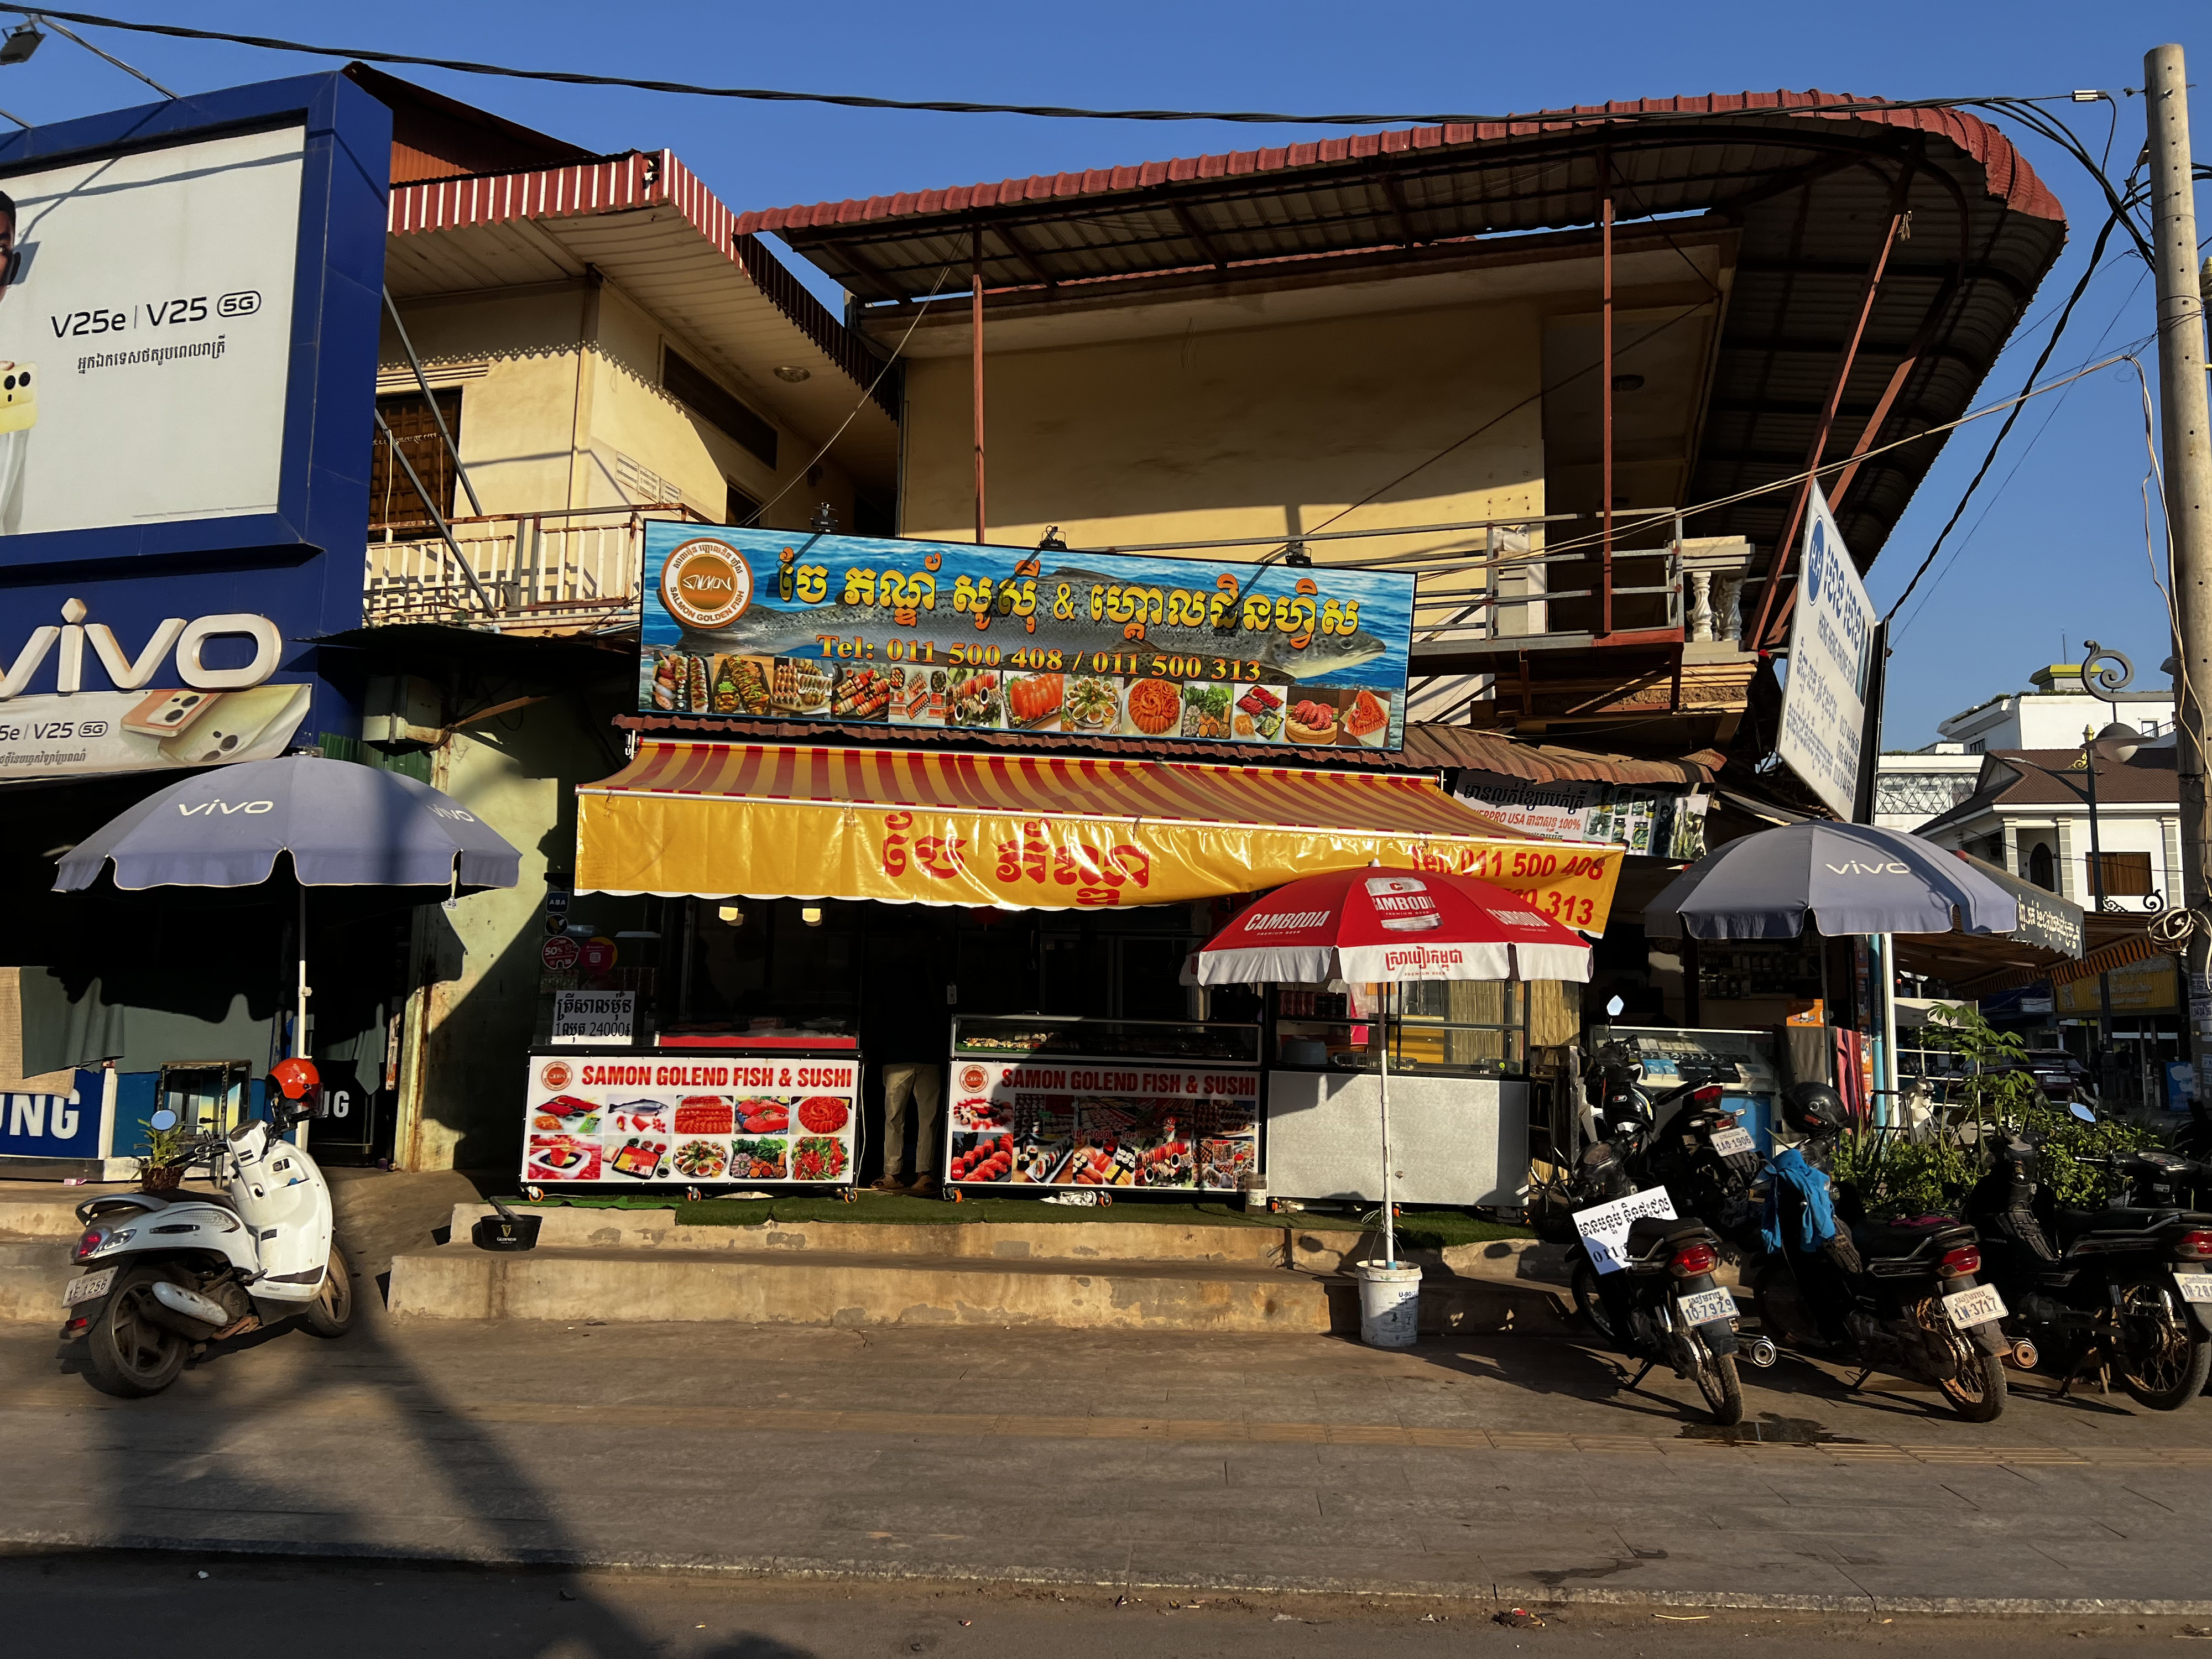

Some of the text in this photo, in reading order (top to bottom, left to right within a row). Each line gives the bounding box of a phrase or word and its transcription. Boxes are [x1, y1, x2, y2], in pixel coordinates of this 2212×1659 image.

[51, 295, 253, 338] V25e V25 5G
[1810, 540, 1823, 581] H.H
[670, 587, 744, 622] SALMON GOLDEN FISH
[1054, 582, 1076, 620] &
[816, 634, 874, 660] Tel:
[886, 638, 936, 664] 011
[948, 642, 1001, 667] 500
[1010, 646, 1064, 671] 408
[1092, 651, 1140, 675] 011
[1151, 655, 1202, 678] 500
[1212, 658, 1261, 681] 313
[34, 722, 75, 740] V25
[82, 724, 104, 734] 5G
[179, 799, 274, 816] vivo
[425, 804, 475, 822] vivo
[1507, 813, 1525, 826] USA
[1558, 818, 1581, 831] 100%
[1461, 849, 1503, 877] 011
[1512, 852, 1557, 878] 500
[1825, 860, 1912, 875] vivo
[1244, 910, 1331, 932] CAMBODIA
[1545, 890, 1594, 926] 313
[557, 993, 633, 1021] ត្រីសាលម៉ុន
[582, 1065, 652, 1086] SAMON
[656, 1065, 728, 1087] GOLEND
[733, 1067, 774, 1087] FISH
[778, 1068, 792, 1087] &
[797, 1068, 852, 1088] SUSHI
[1001, 1068, 1066, 1090] SAMON
[1070, 1070, 1139, 1092] GOLEND
[1142, 1073, 1181, 1093] FISH
[1185, 1074, 1198, 1094] &
[1203, 1075, 1256, 1096] SUSHI
[0, 1088, 80, 1140] NG
[1593, 1246, 1621, 1263] 011
